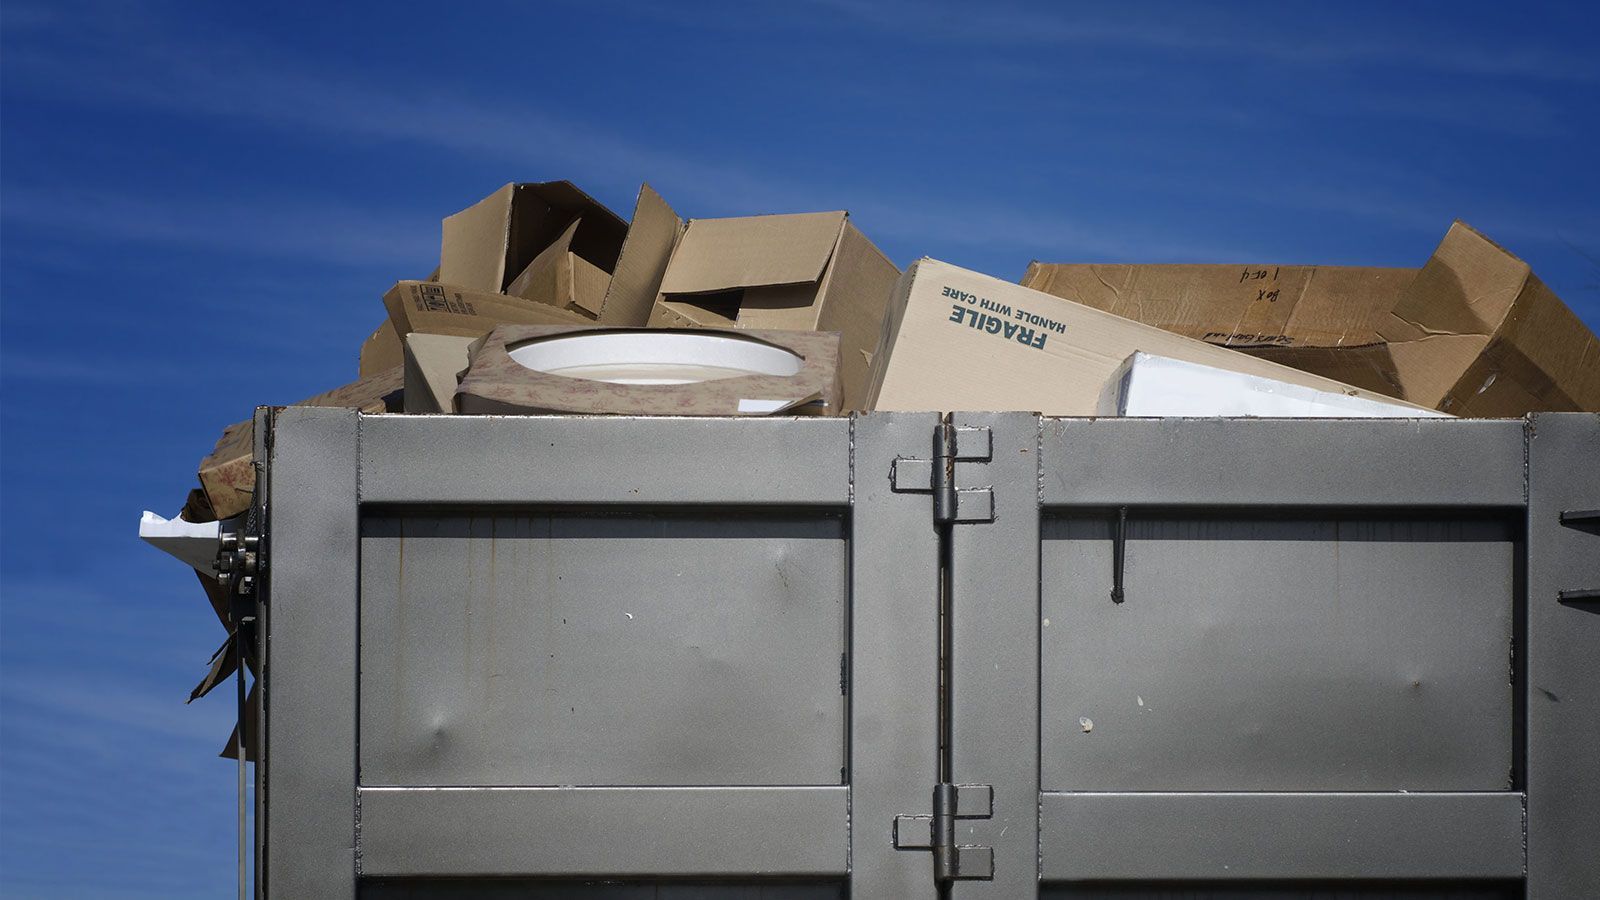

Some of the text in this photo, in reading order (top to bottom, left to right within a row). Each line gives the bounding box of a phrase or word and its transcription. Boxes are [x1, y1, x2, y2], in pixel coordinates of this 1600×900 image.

[1240, 267, 1250, 283] 4
[942, 286, 1066, 334] HANDLE WITH CARE
[949, 304, 1047, 350] FRAGILE
